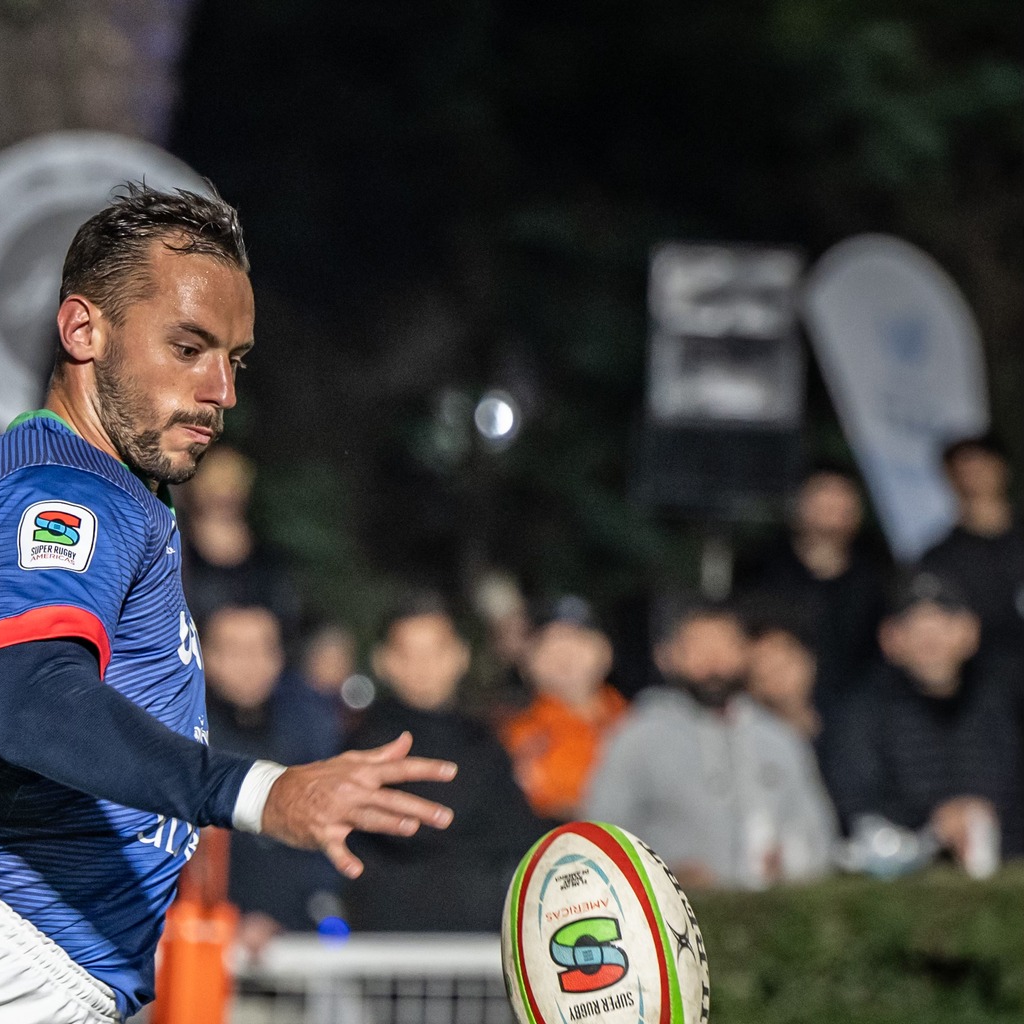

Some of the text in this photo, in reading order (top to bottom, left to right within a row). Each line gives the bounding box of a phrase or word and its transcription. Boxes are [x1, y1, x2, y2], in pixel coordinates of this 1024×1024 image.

[30, 553, 75, 565] AMERICAS
[31, 545, 76, 560] SUPER RUGBY
[545, 898, 609, 922] AMERICAS
[569, 991, 635, 1021] SUPER RUGBY
